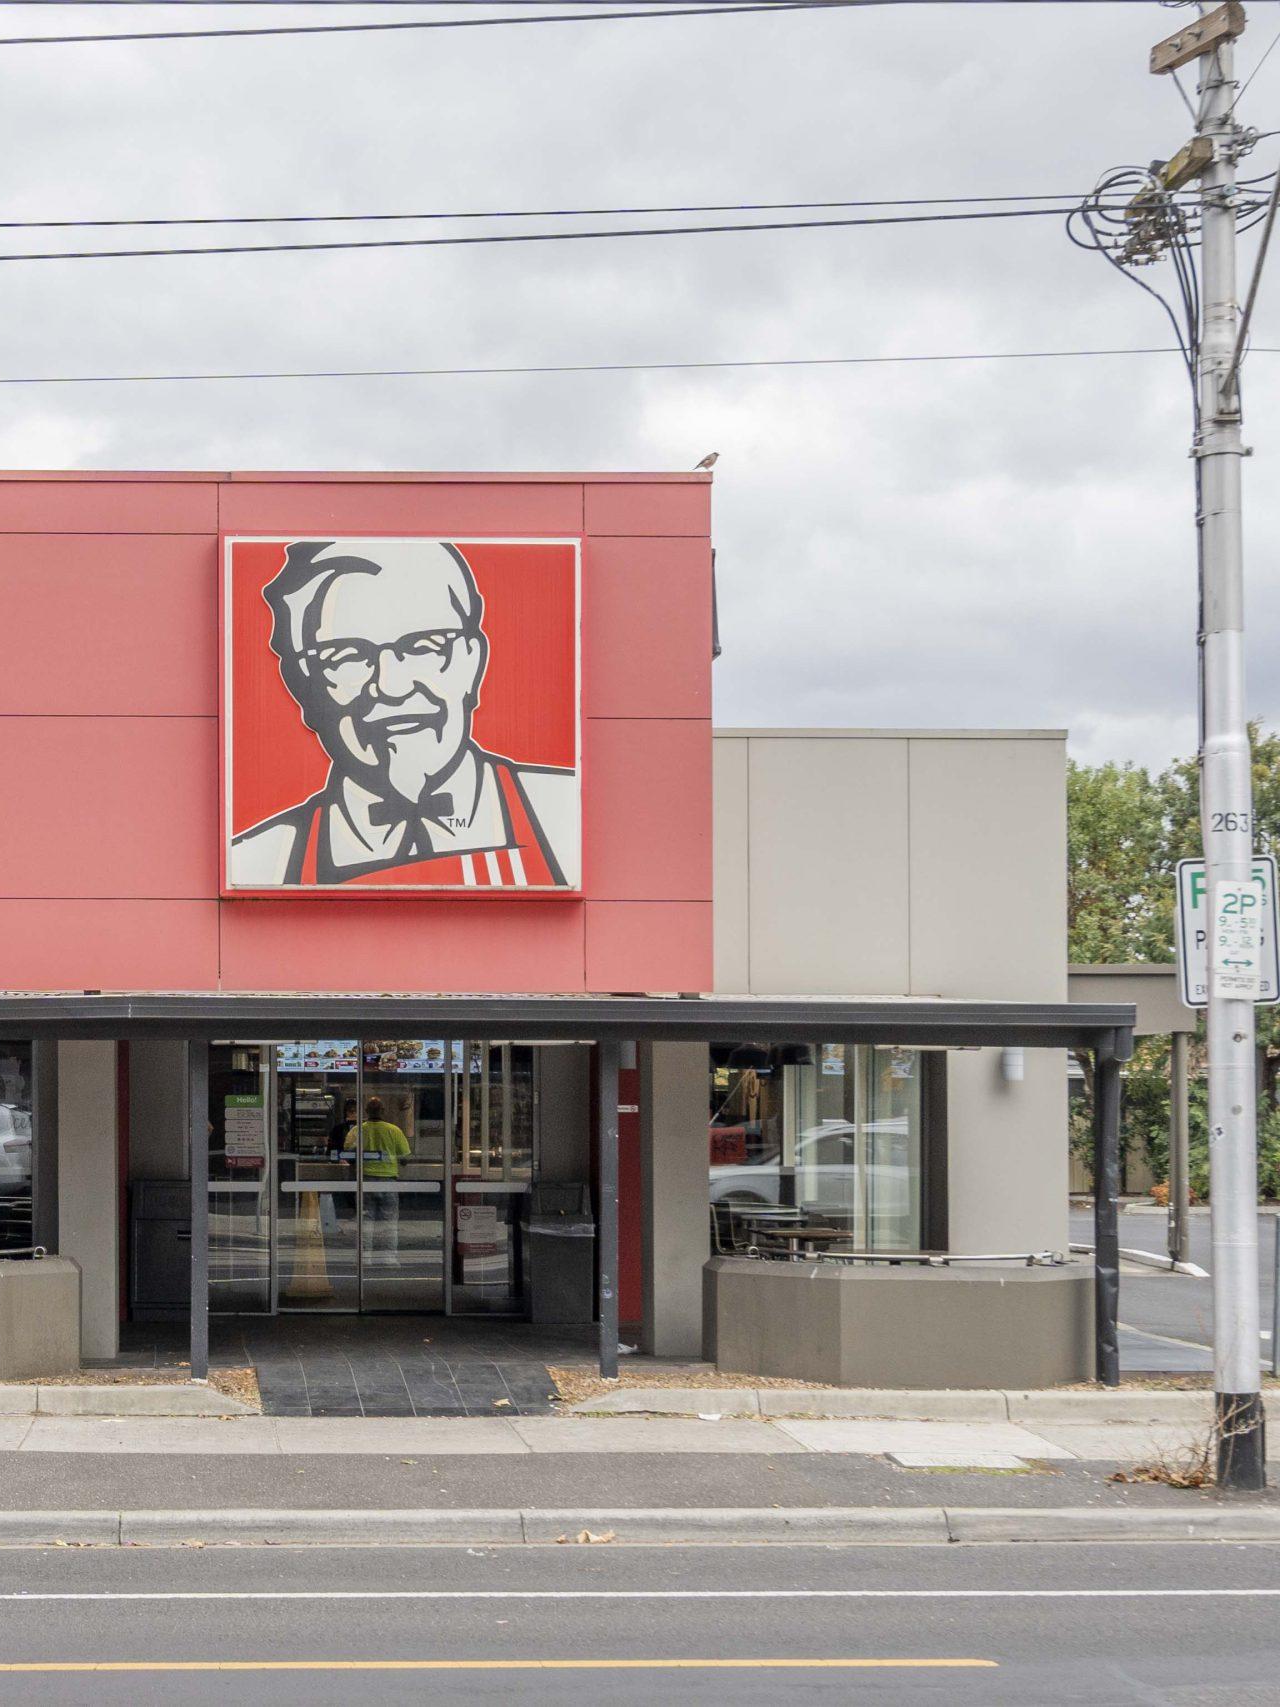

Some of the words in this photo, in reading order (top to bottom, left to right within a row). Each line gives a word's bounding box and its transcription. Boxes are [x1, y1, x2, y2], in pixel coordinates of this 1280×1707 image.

[447, 818, 466, 828] TM
[1211, 812, 1249, 832] 263
[1222, 892, 1256, 915] 2P
